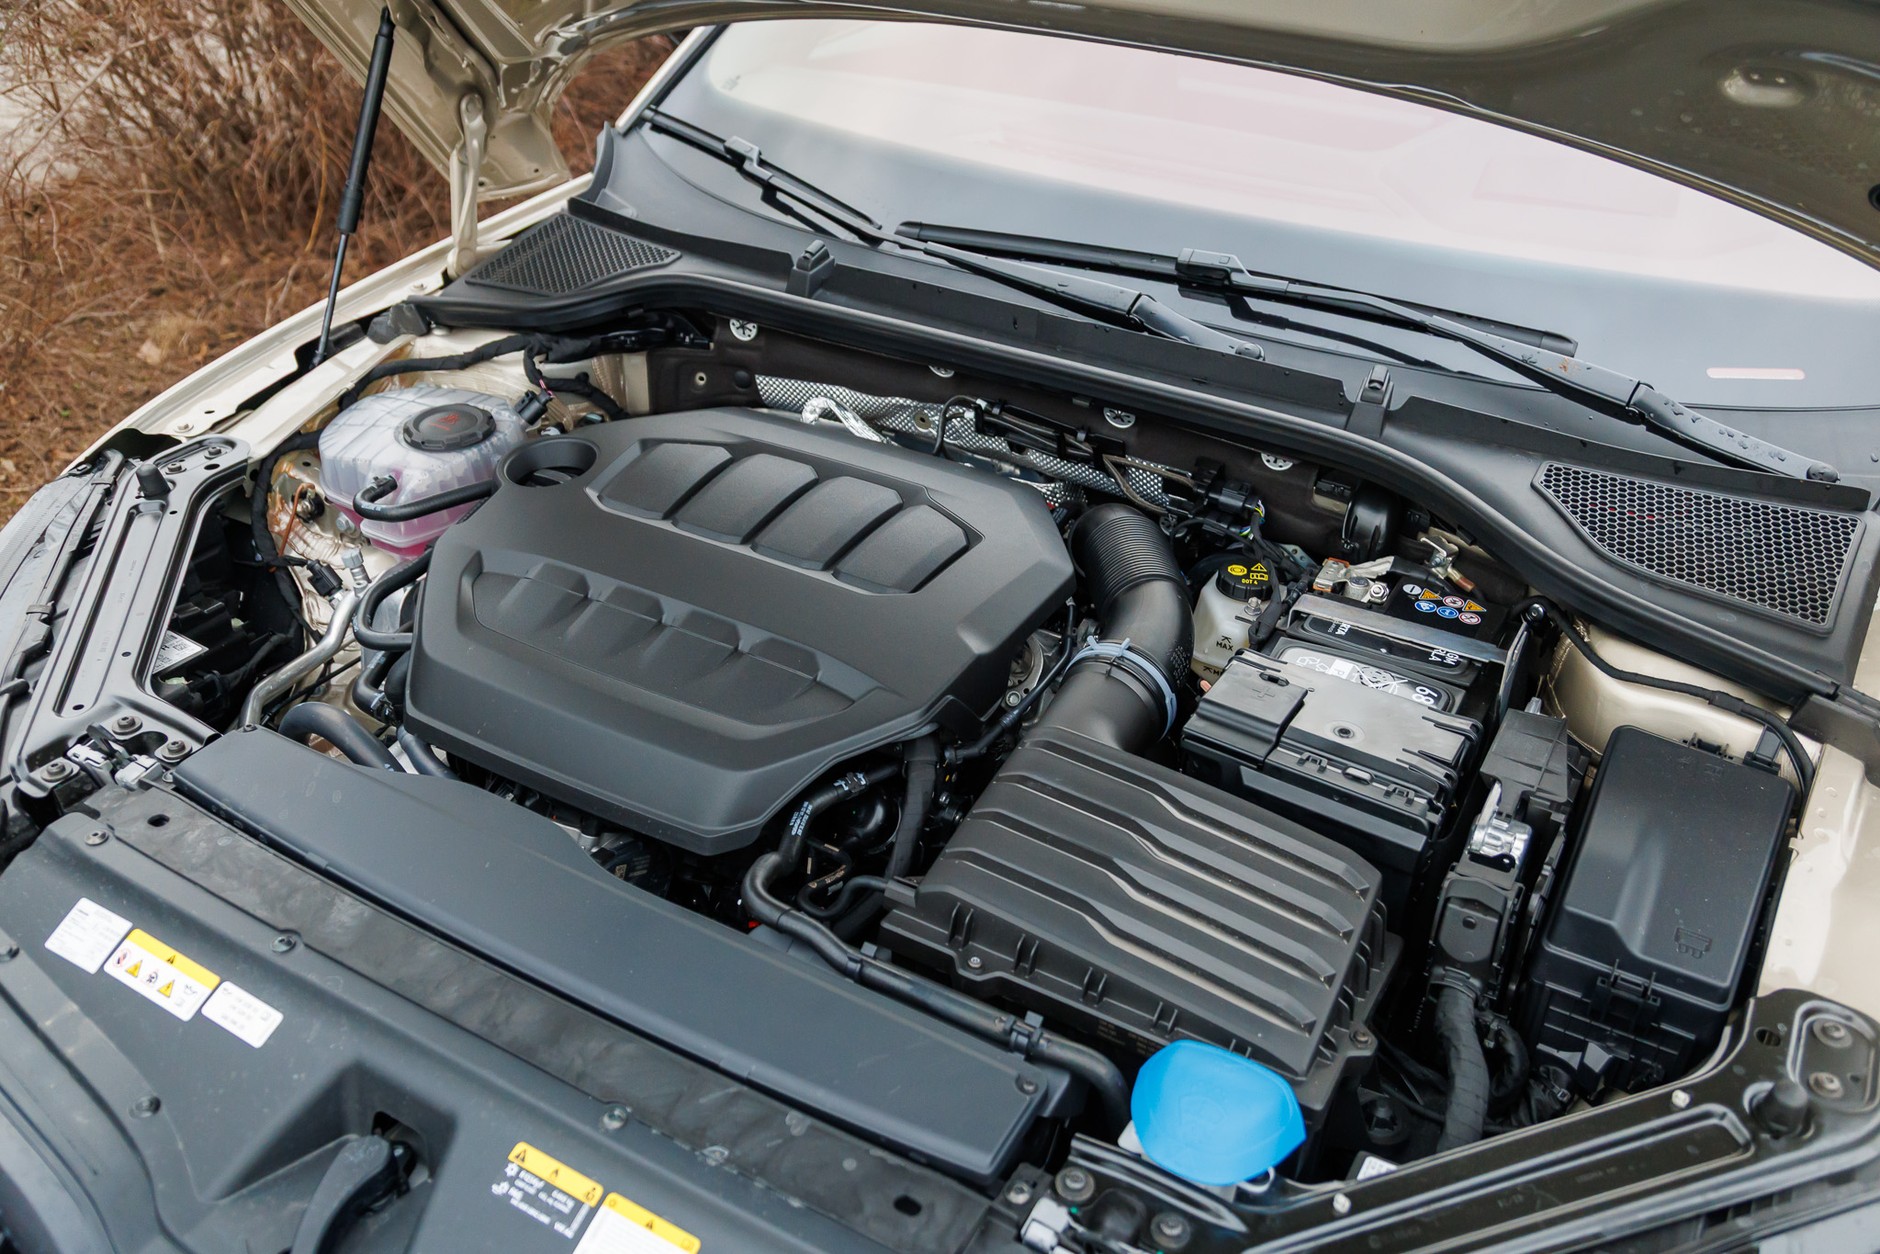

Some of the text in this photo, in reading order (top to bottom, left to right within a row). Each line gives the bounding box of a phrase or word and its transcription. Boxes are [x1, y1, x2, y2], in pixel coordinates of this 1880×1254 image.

[1216, 641, 1234, 652] MAX
[1428, 649, 1447, 662] RLA
[1443, 652, 1460, 666] GM
[1412, 686, 1438, 705] 68
